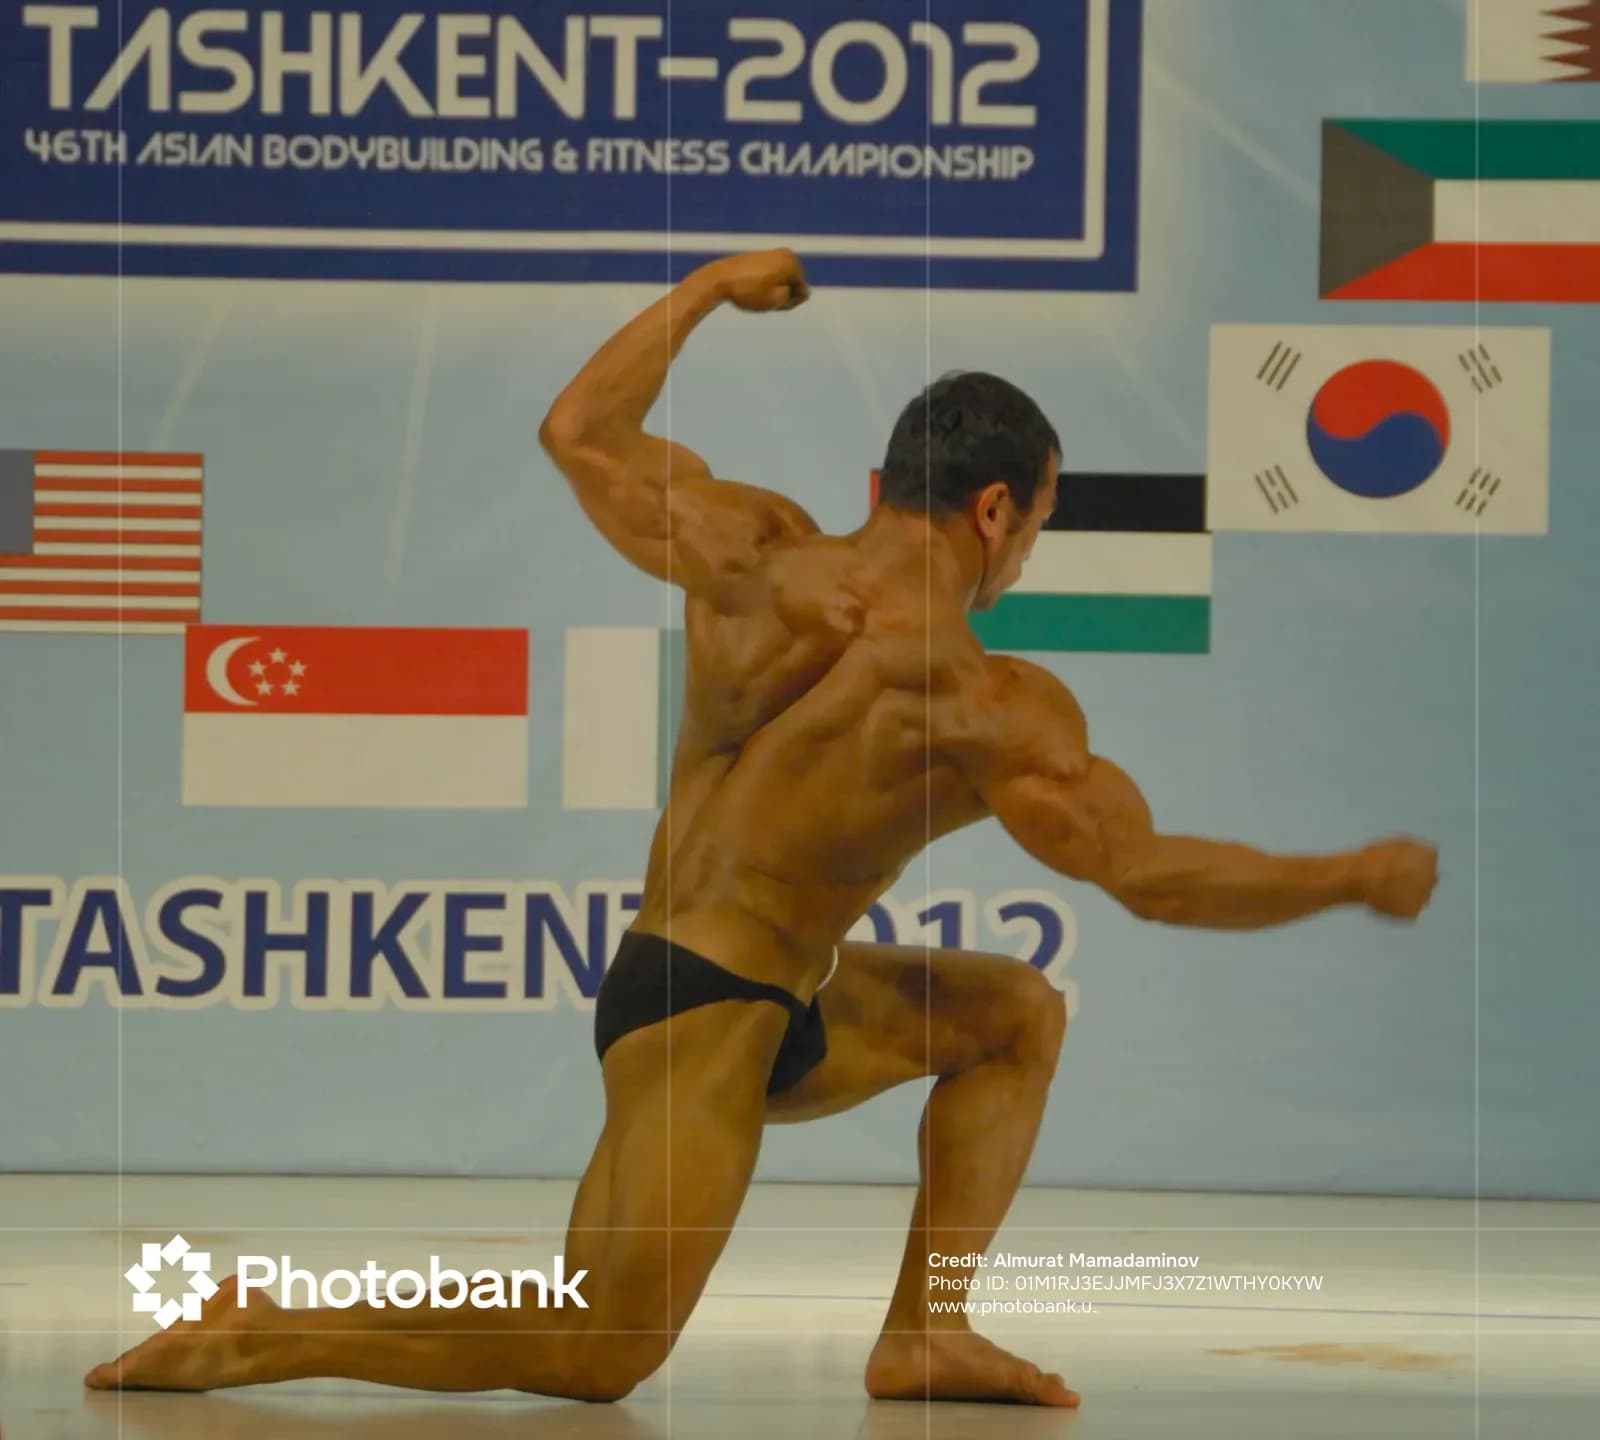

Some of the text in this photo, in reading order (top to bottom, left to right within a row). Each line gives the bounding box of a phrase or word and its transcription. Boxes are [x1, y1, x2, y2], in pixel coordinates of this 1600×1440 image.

[23, 5, 1040, 127] TASHKENT-2012
[24, 128, 1035, 181] 46TH ASIAN BODYBUILDING & FITNESS CHAMPIONSHIP
[0, 888, 644, 999] TASHKEN
